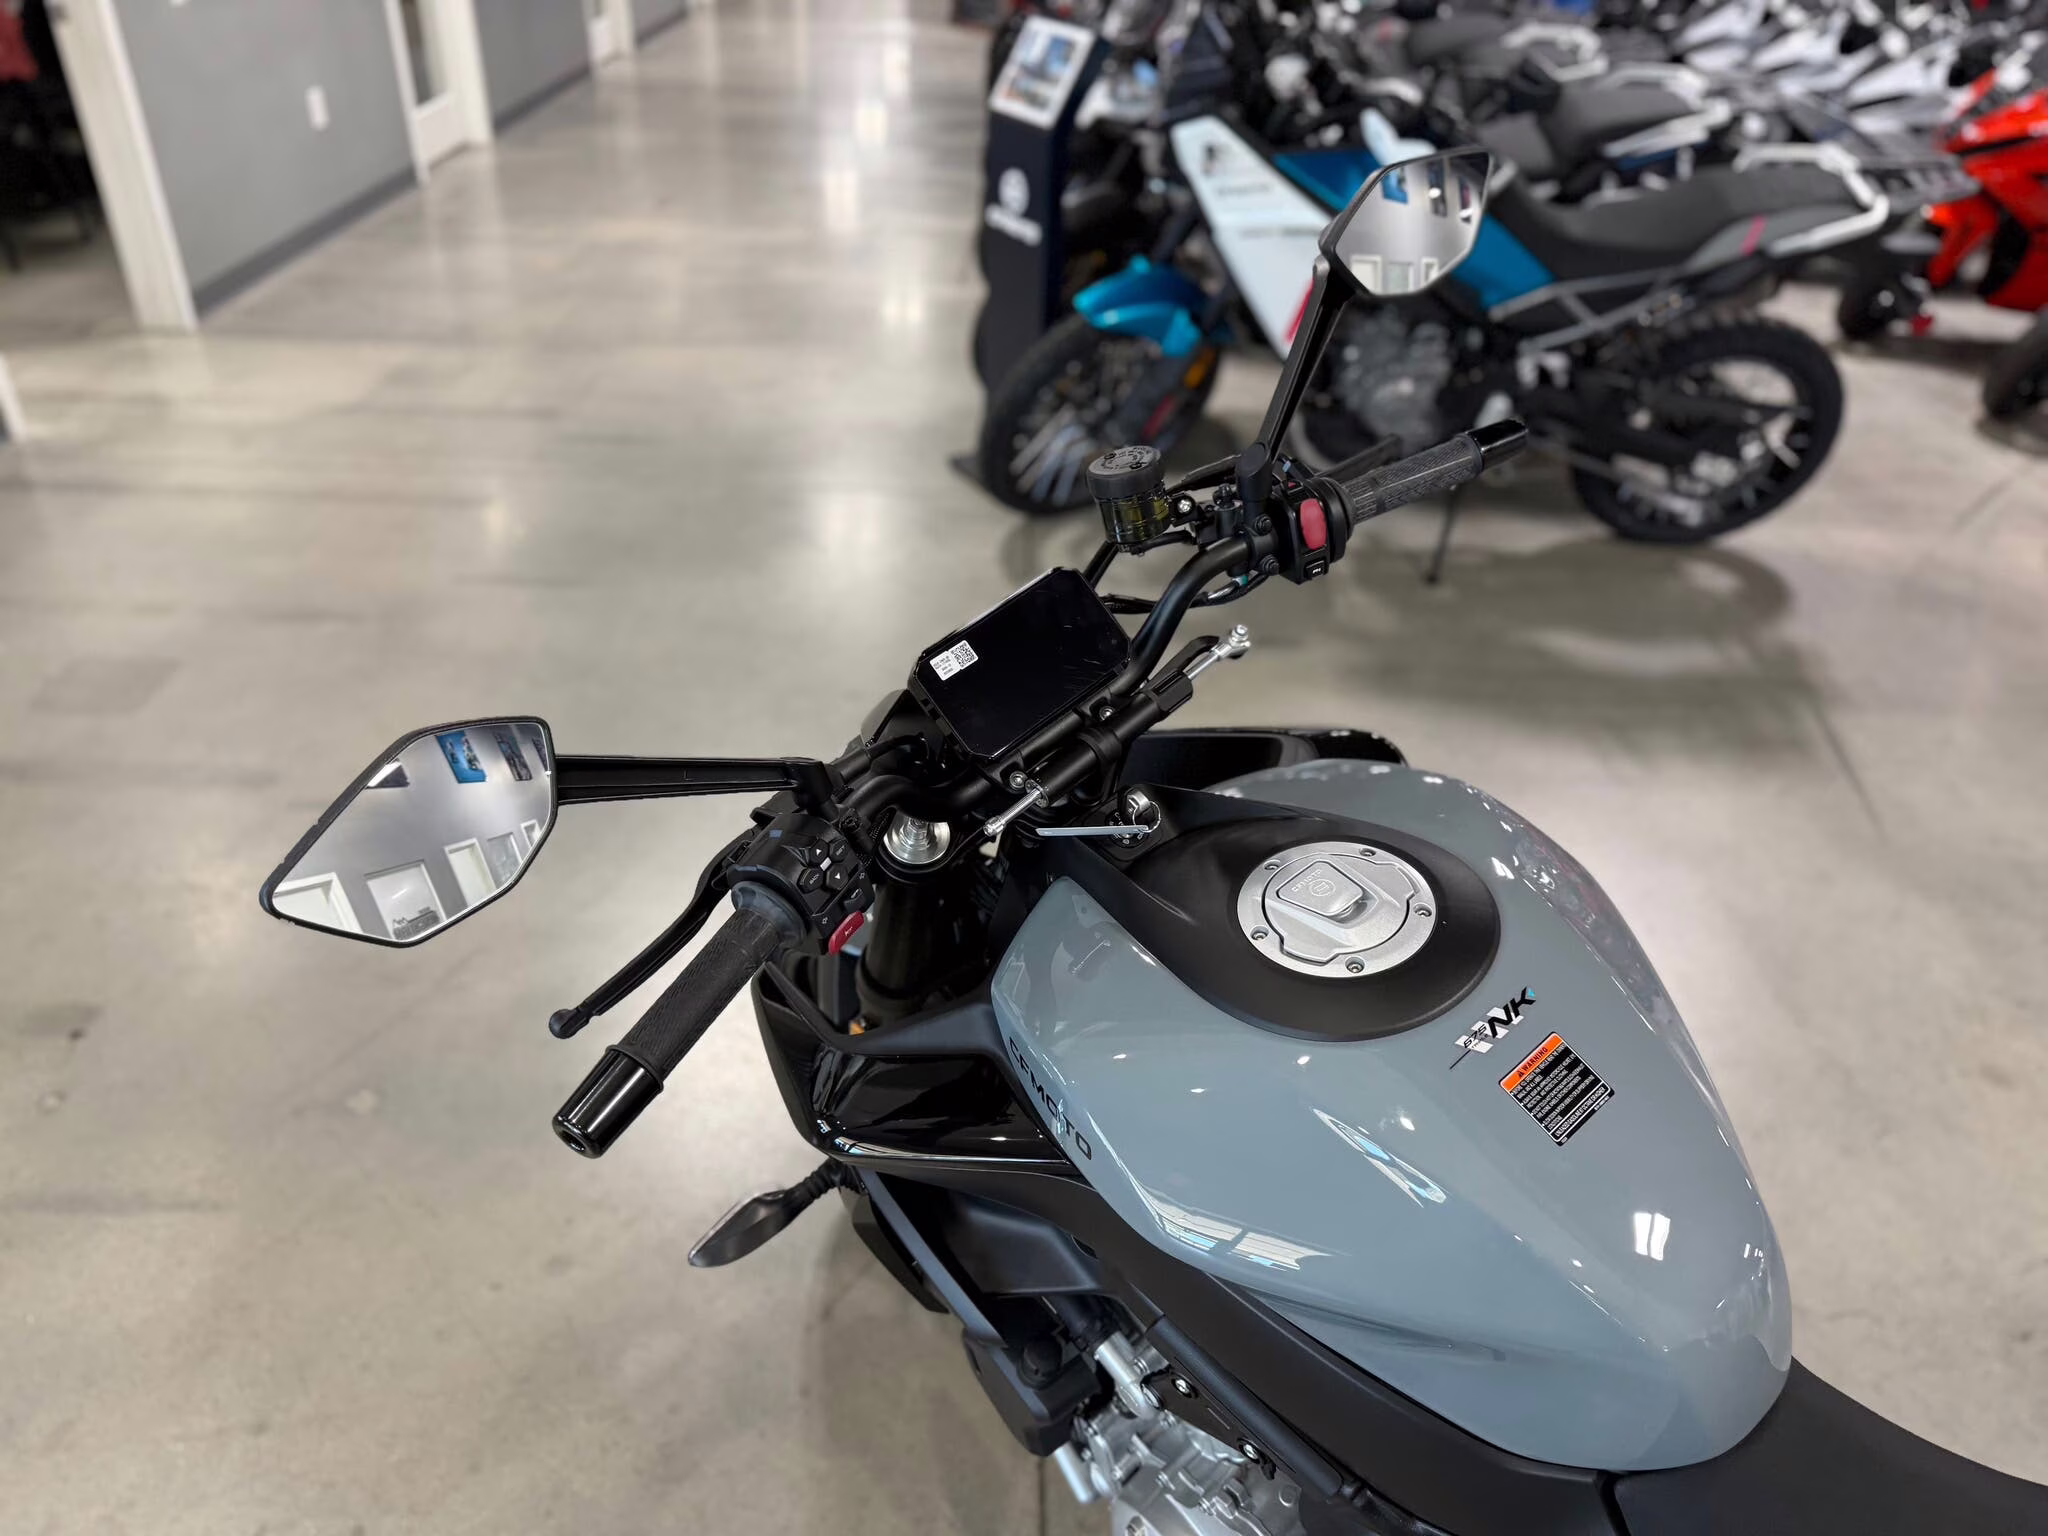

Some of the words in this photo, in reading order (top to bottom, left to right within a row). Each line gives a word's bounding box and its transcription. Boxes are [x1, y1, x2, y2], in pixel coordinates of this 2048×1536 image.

[1463, 1024, 1487, 1049] 675
[1487, 986, 1537, 1039] NK
[1523, 1046, 1549, 1073] WARNING
[1009, 1037, 1092, 1160] CFMOTO
